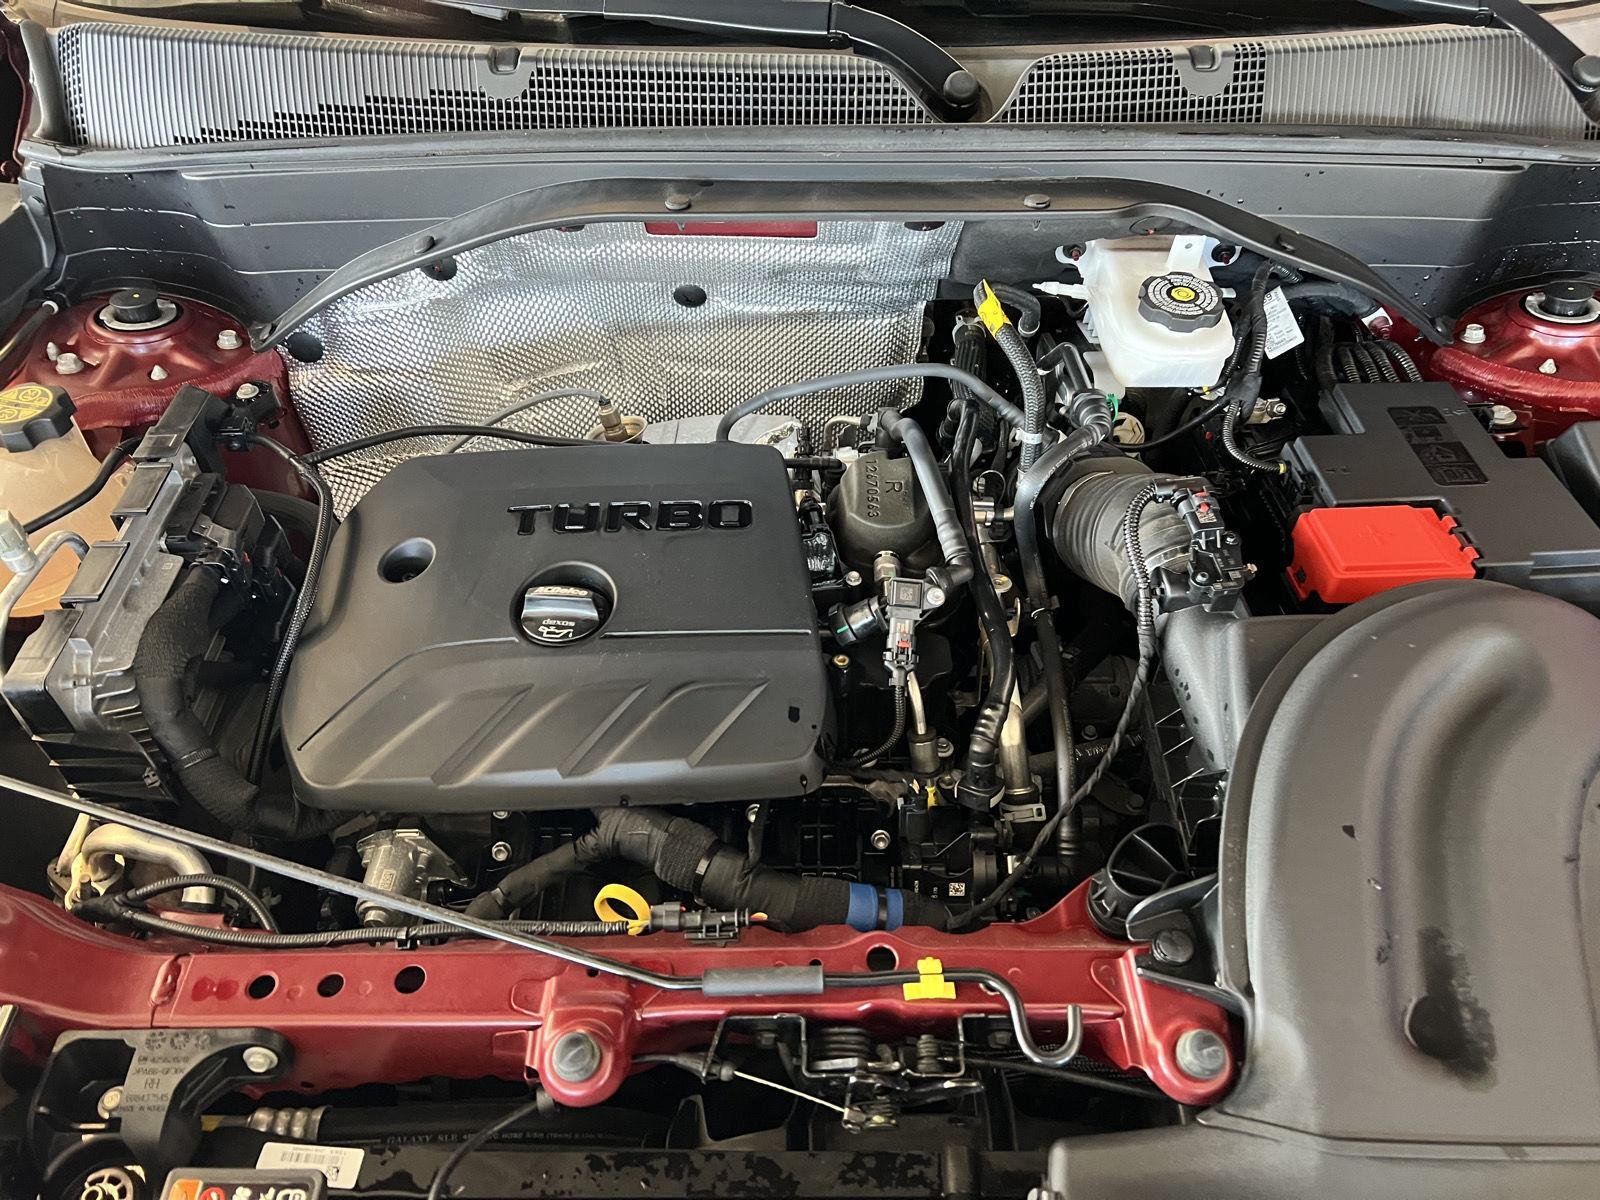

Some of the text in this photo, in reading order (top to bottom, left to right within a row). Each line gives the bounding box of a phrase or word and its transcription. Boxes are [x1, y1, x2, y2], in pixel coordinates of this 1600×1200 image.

[865, 460, 881, 518] 12670563
[885, 481, 904, 494] R
[507, 500, 753, 535] TURBO
[534, 586, 589, 597] ACDelco
[542, 618, 576, 627] dexos
[386, 1133, 433, 1145] GALAXY
